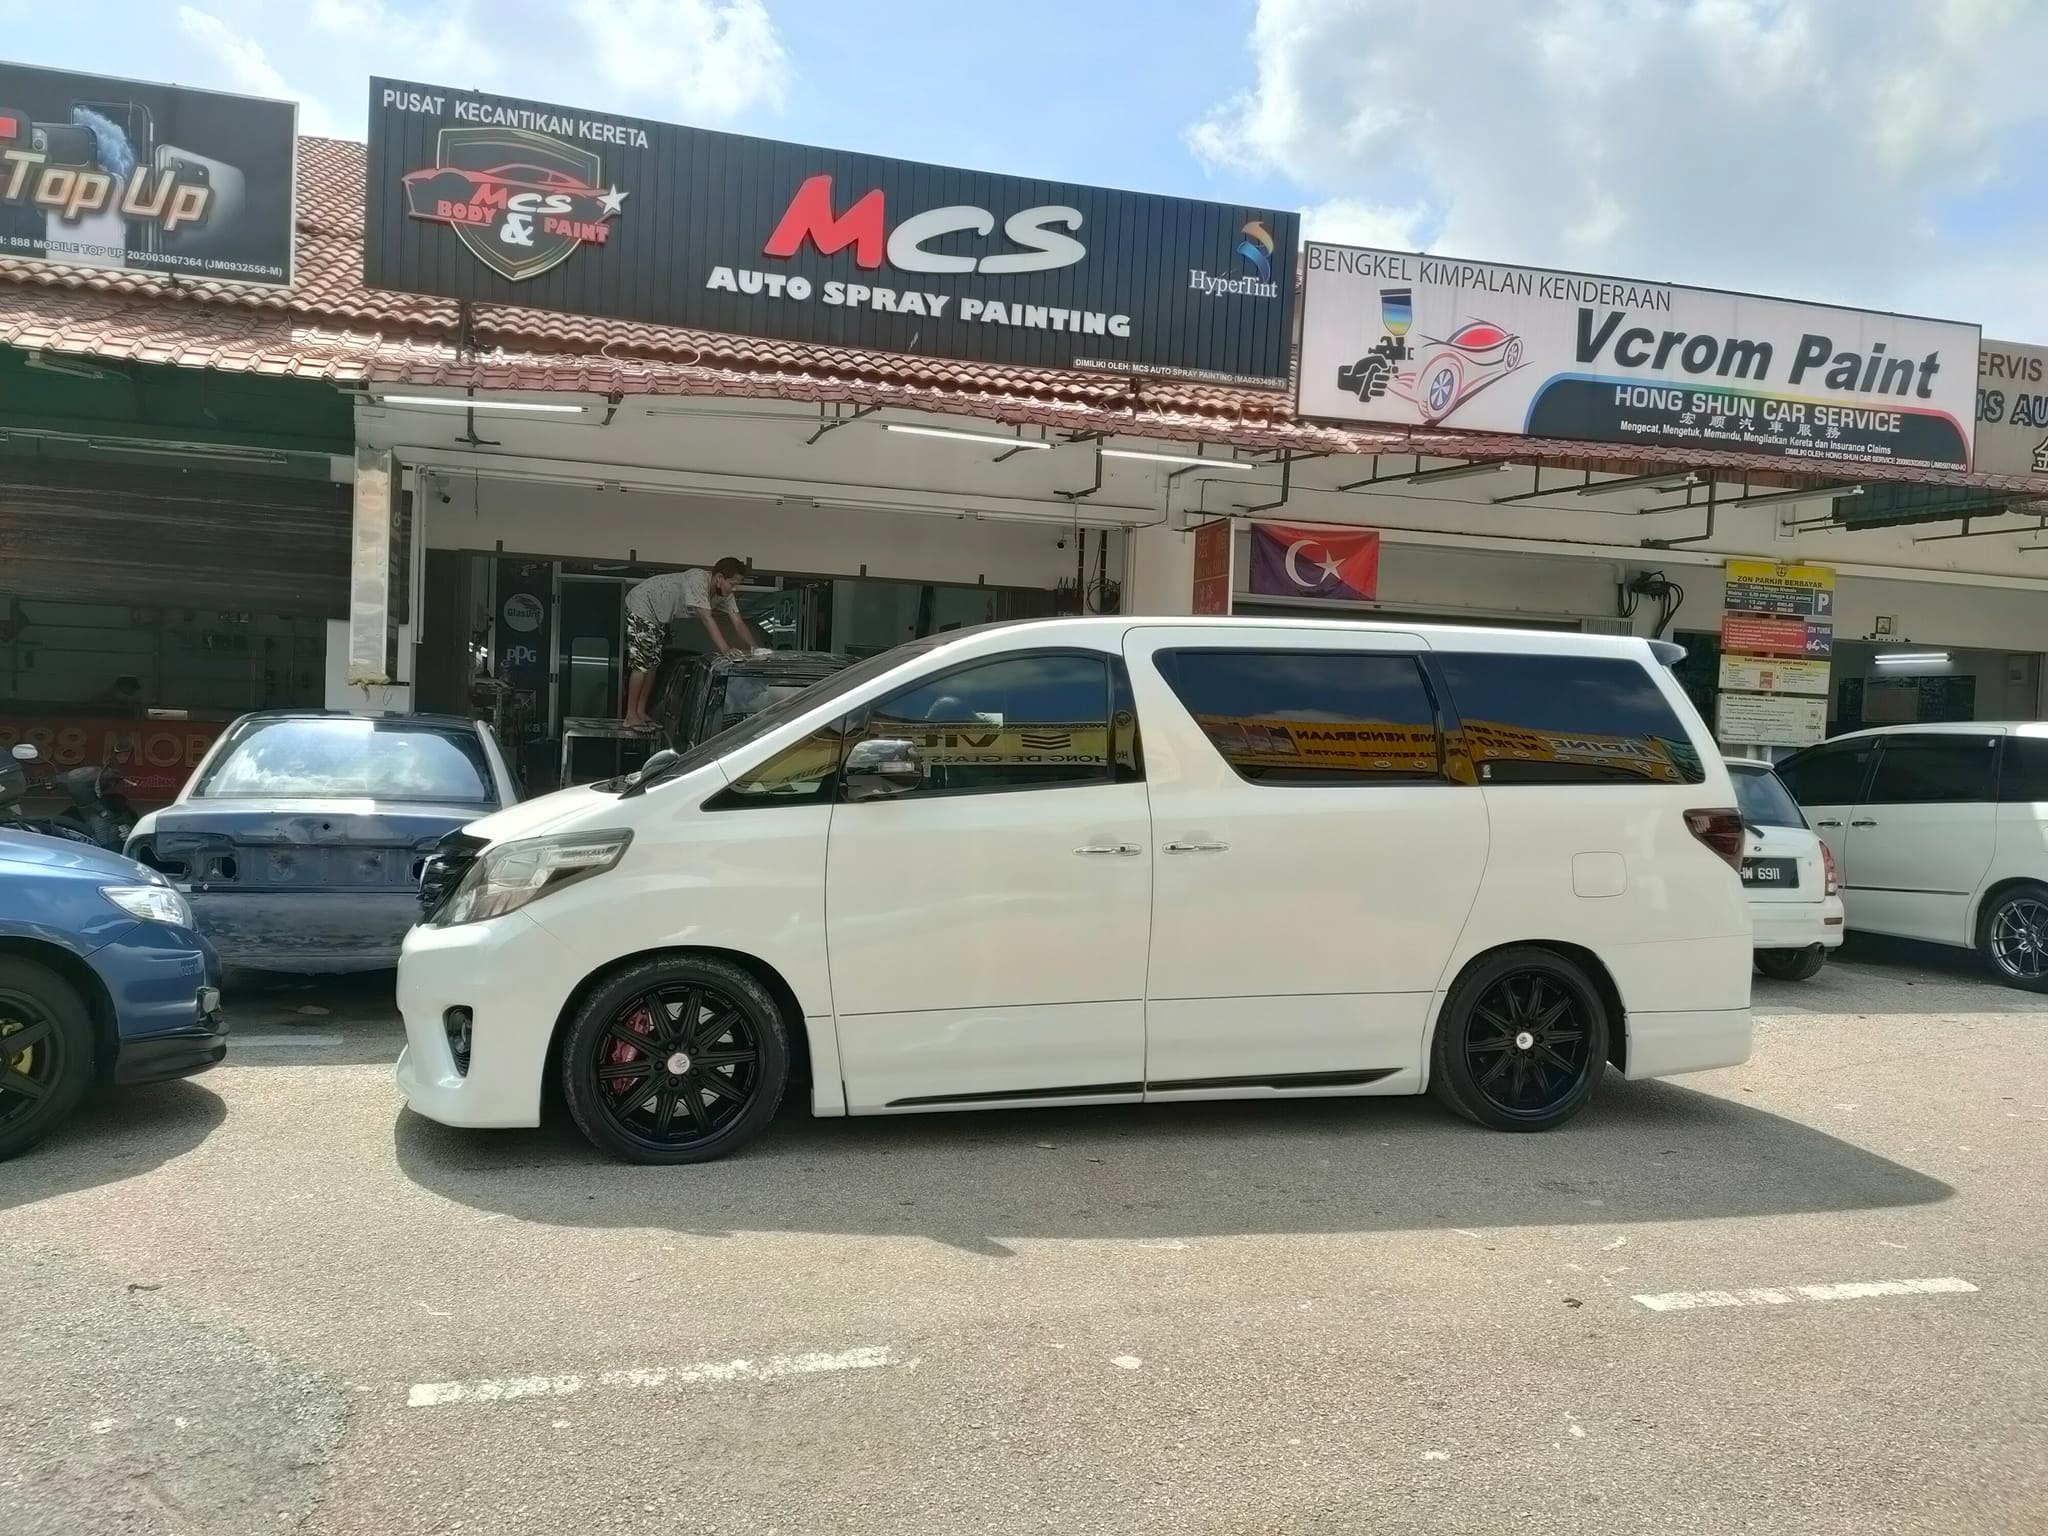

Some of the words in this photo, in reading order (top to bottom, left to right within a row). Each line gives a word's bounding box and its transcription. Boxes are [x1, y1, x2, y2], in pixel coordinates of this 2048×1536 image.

[383, 89, 445, 116] PUSAT
[455, 100, 575, 138] KECANTIKAN
[579, 118, 649, 149] KERETA
[4, 150, 111, 220] Top
[121, 166, 209, 231] Up
[470, 183, 573, 214] MCS
[437, 200, 497, 224] BODY
[763, 174, 1087, 274] MCS
[500, 213, 534, 247] &
[544, 216, 610, 244] PAINT
[10, 236, 30, 248] 888
[33, 239, 80, 253] MOBILE
[81, 244, 106, 256] TOP
[108, 247, 124, 258] UP
[127, 250, 202, 267] 202003067364
[1189, 268, 1278, 298] HyperTint
[1309, 247, 1413, 281] BENGKEL
[1419, 261, 1533, 297] KIMPALAN
[1538, 276, 1672, 312] KENDERAAN
[706, 266, 812, 300] AUTO
[822, 281, 950, 318] SPRAY
[960, 297, 1131, 338] PAINTING
[1575, 307, 1775, 381] Vcrom
[1788, 333, 1941, 399] Paint
[1075, 358, 1106, 369] DIMILIKI
[1107, 361, 1131, 371] OLEH:
[1132, 363, 1149, 373] MCS
[1150, 365, 1171, 375] AUTO
[1172, 368, 1198, 378] SPRAY
[1199, 370, 1233, 382] PAINTING
[1614, 385, 1682, 410] HONG
[1691, 393, 1755, 418] SHUN
[1763, 400, 1805, 424] CAR
[1814, 406, 1901, 433] SERVICE
[1620, 420, 1661, 435] Mengecat,
[1662, 424, 1702, 439] Mengetuk,
[1703, 428, 1742, 442] Memandu,
[1743, 431, 1788, 446] Mengilatkan
[1789, 436, 1813, 448] Kereta
[1814, 439, 1828, 449] dan
[1830, 441, 1865, 453] Insurance
[1867, 443, 1892, 455] Claims
[1825, 450, 1842, 461] HONG
[1843, 452, 1858, 462] SHUN
[1859, 454, 1872, 463] CAR
[1872, 455, 1896, 465] SERVICE
[1737, 575, 1753, 583] ZON
[1755, 576, 1783, 585] PARKIR
[1784, 578, 1823, 588] BERBAYAR
[1817, 593, 1830, 612] P
[506, 645, 537, 665] PPG
[1758, 867, 1780, 880] 6911
